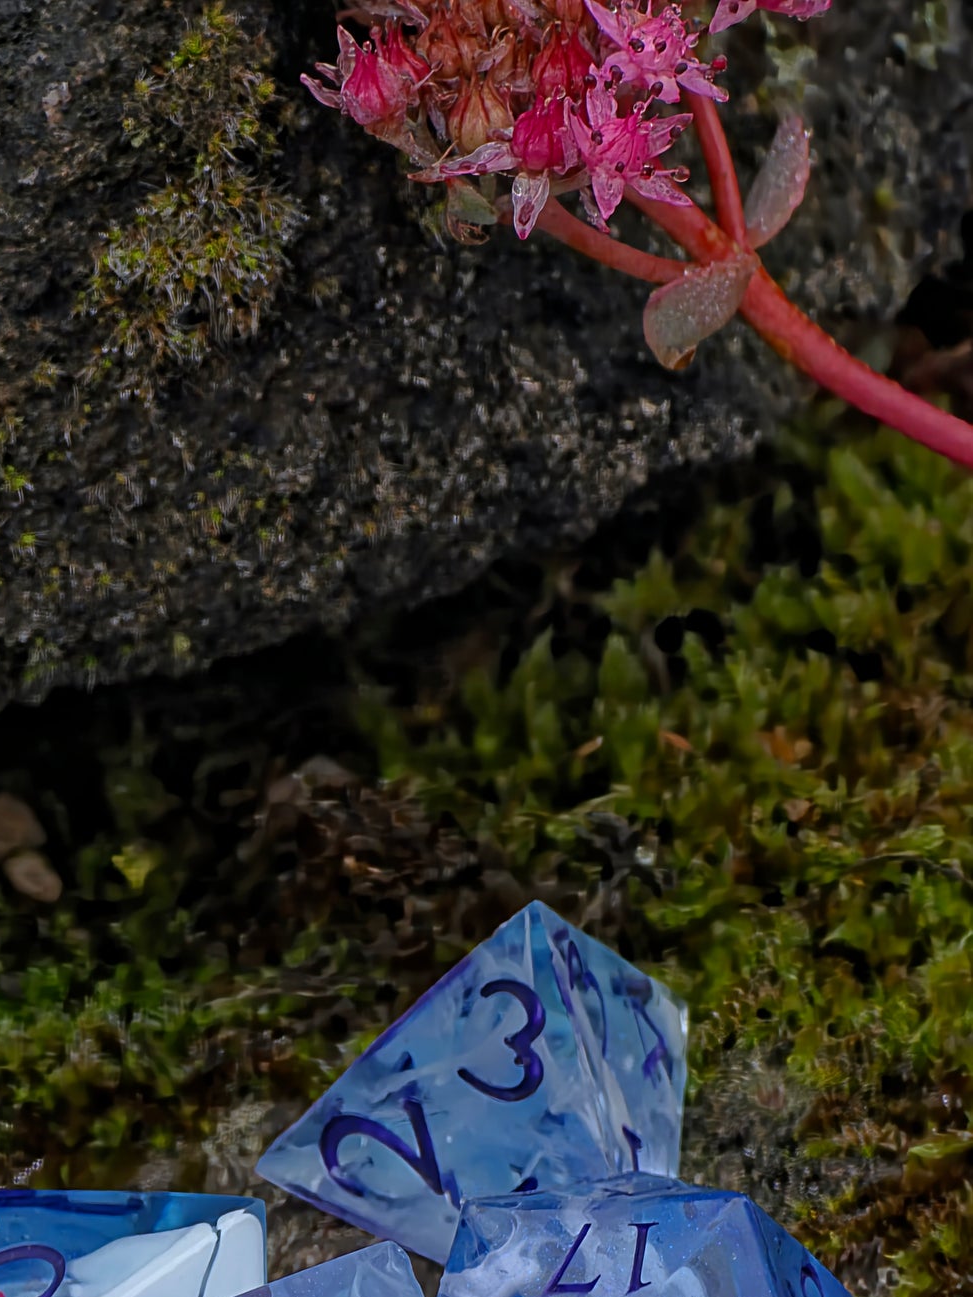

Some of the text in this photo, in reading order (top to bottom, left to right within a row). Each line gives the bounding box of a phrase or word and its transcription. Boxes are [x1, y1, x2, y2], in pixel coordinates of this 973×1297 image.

[457, 979, 546, 1101] 3
[318, 1098, 445, 1198] 2
[549, 1222, 660, 1297] 17
